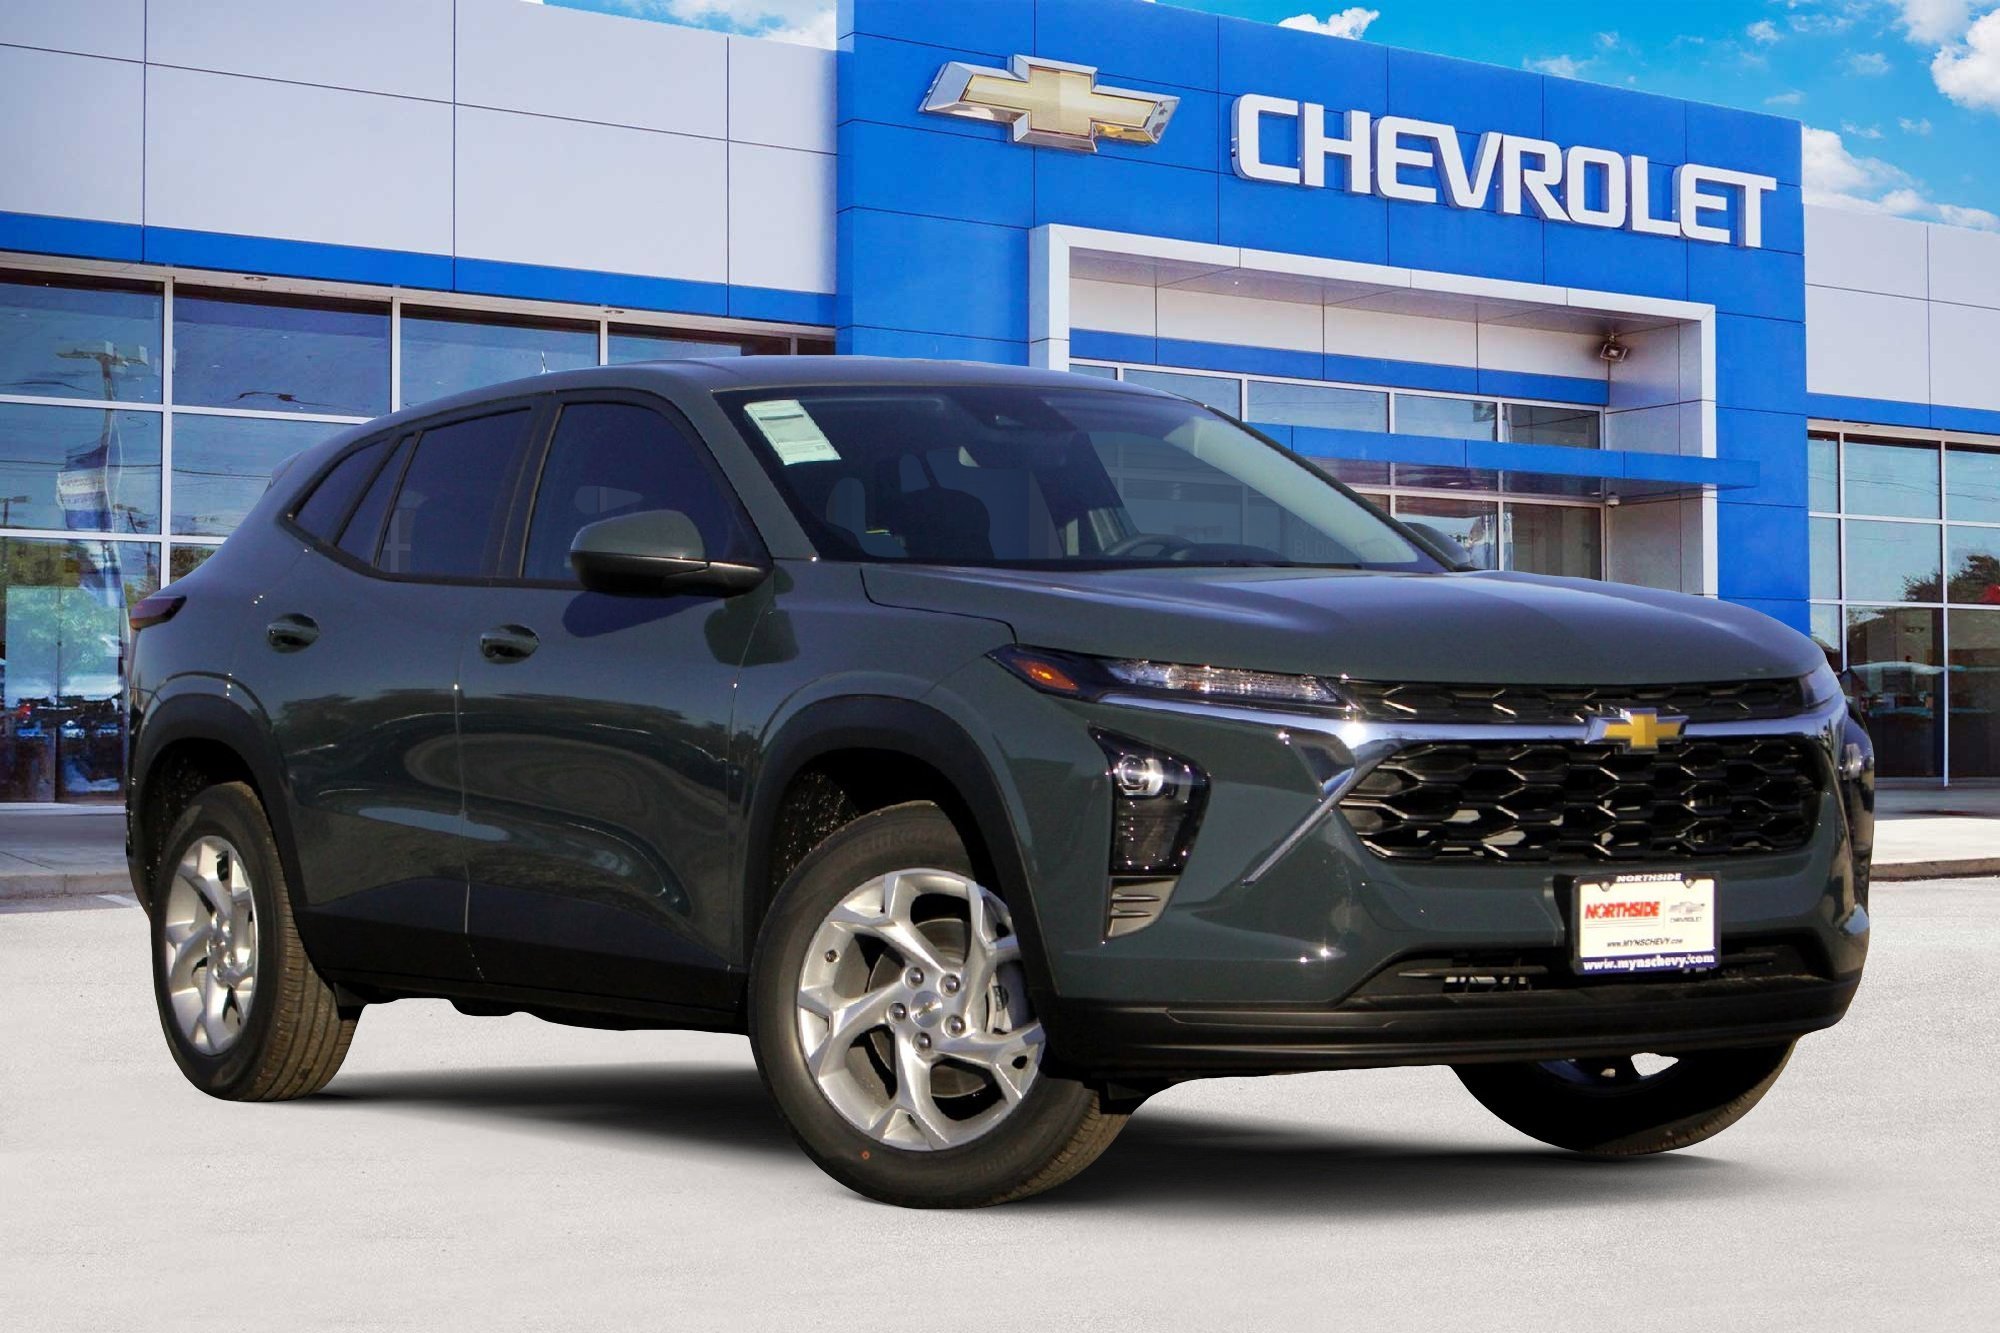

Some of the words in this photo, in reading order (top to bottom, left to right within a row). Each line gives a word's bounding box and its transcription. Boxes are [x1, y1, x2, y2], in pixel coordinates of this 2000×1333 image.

[1231, 93, 1777, 248] CHEVROLET
[1616, 872, 1682, 883] NORTHSIDE
[1585, 901, 1661, 919] NORTHSIDE
[1583, 954, 1715, 972] www.mynschevy.com
